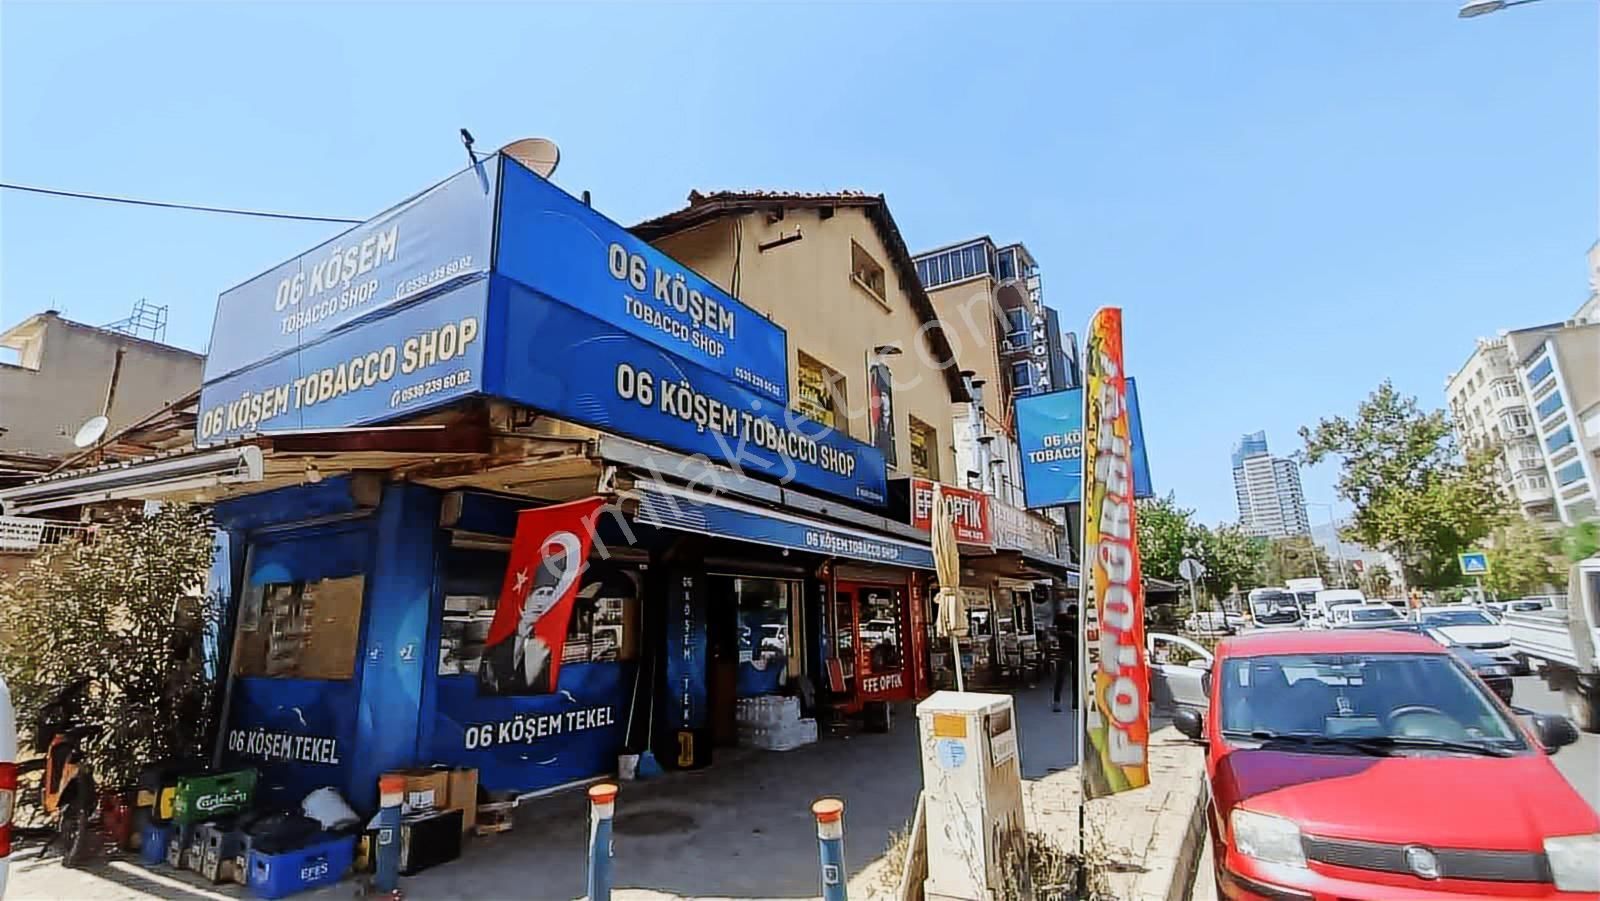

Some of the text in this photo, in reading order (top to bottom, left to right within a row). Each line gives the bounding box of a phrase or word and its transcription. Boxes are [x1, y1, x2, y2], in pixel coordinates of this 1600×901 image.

[275, 224, 399, 311] 06 KÖŞEM
[280, 280, 379, 337] TOBACCO SHOP
[609, 243, 736, 340] 06 KÖŞEM
[624, 294, 726, 361] TOBACCO SHOP
[201, 317, 478, 439] 06 KÖŞEM TOBACCO SHOP
[425, 378, 442, 395] 239
[457, 371, 471, 386] 02
[616, 362, 654, 406] 06
[658, 377, 739, 438] KÖŞEM
[740, 411, 819, 466] TOBACCO
[820, 446, 856, 478] SHOP
[1064, 427, 1081, 445] KÖ
[1028, 446, 1081, 464] TOBACC
[916, 488, 933, 519] EF
[228, 728, 340, 764] 06 KÖŞEM TEKEL
[464, 706, 615, 749] 06 KÖŞEM TEKEL
[301, 862, 329, 880] EFES
